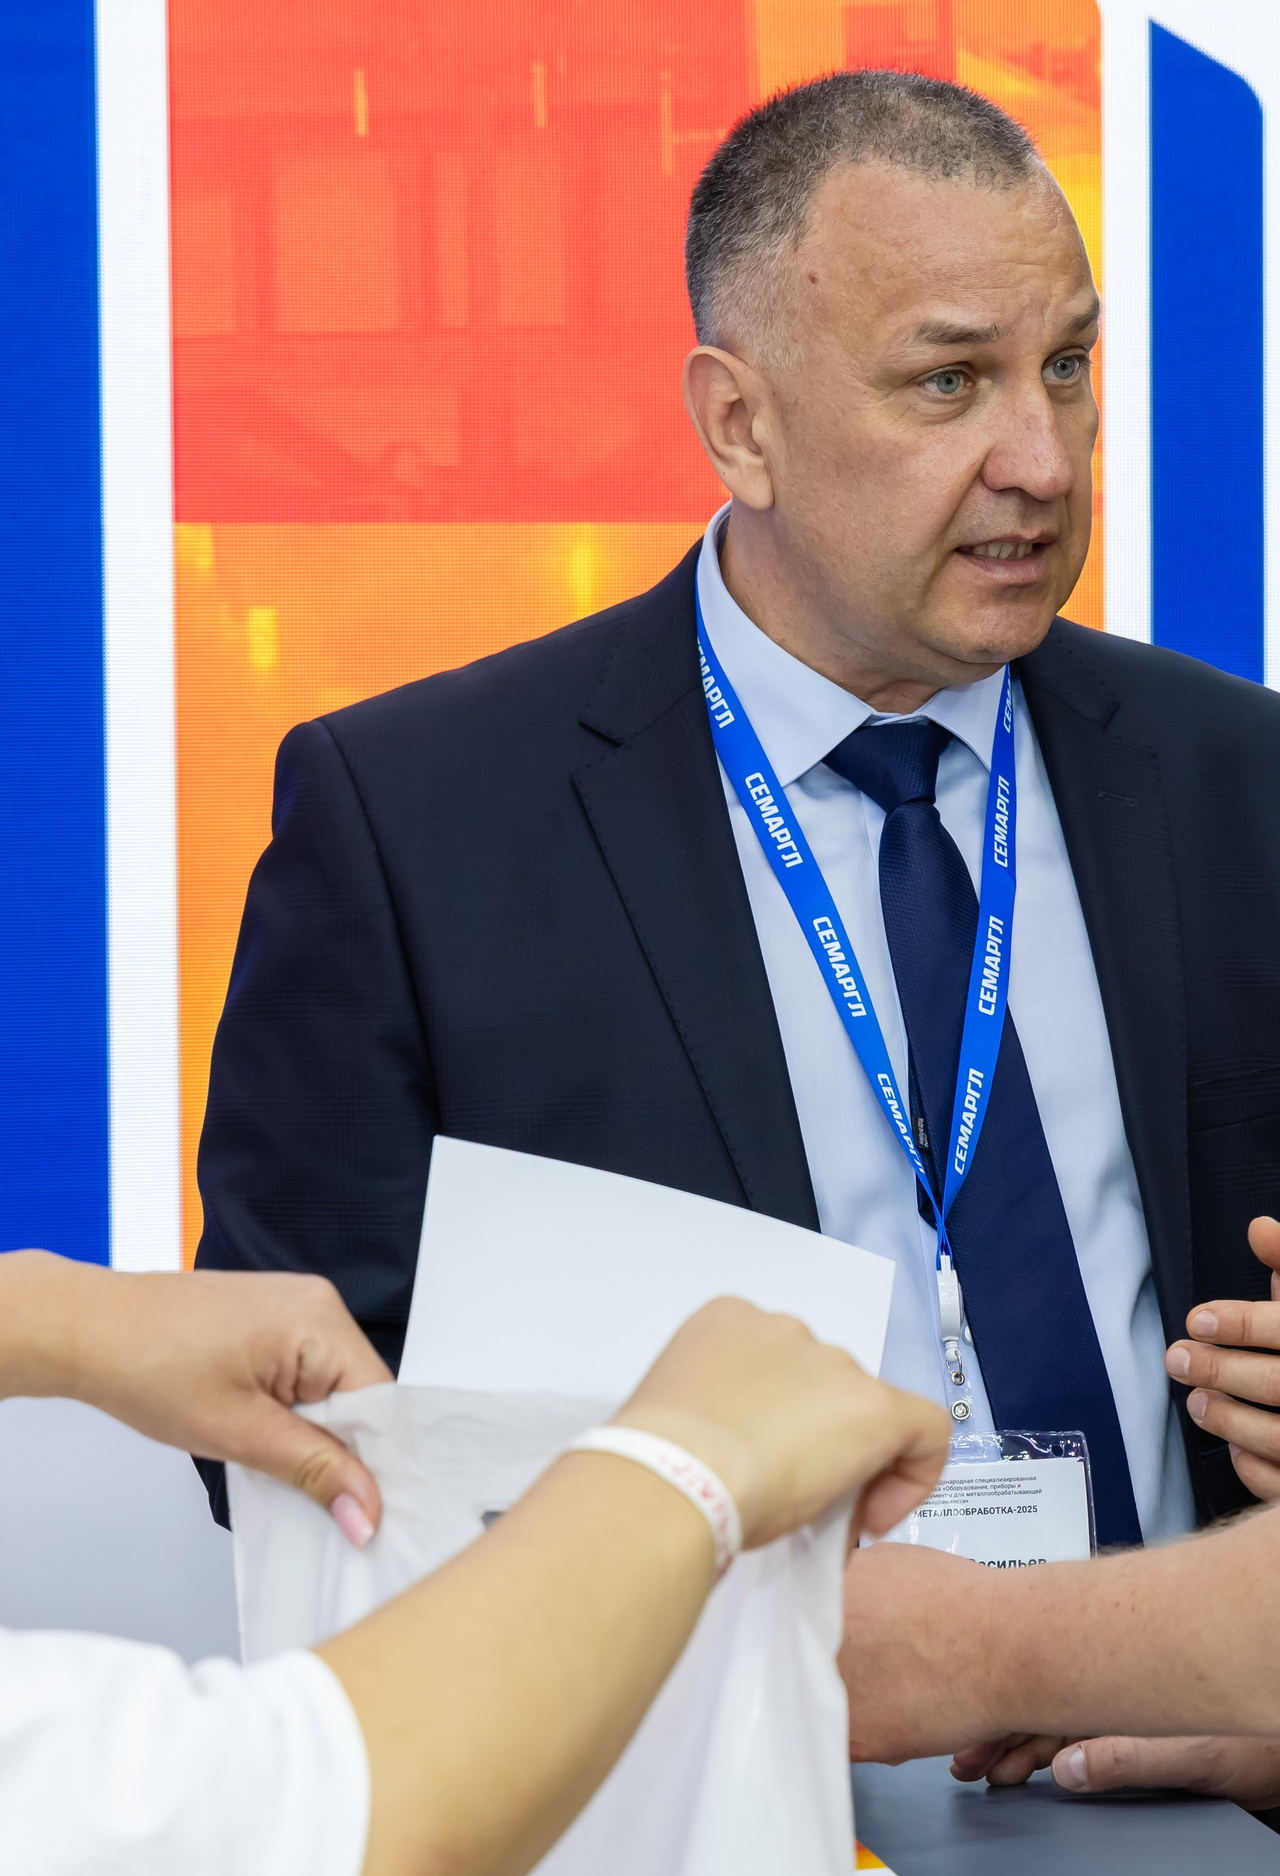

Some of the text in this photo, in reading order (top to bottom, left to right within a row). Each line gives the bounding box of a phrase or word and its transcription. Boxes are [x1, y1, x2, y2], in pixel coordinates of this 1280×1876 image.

[697, 636, 735, 729] МАРГЛ
[744, 771, 804, 869] СЕМАРГЛ
[994, 774, 1010, 868] СЕМАРГЛ
[812, 915, 868, 1018] СЕМАРГЛ
[978, 914, 1004, 1016] СЕМАРГЛ
[954, 1067, 985, 1176] СЕМАРГЛ
[914, 1505, 1038, 1518] МЕТАЛЛООБРАБОТКА-2025
[975, 1476, 1037, 1485] специализированная
